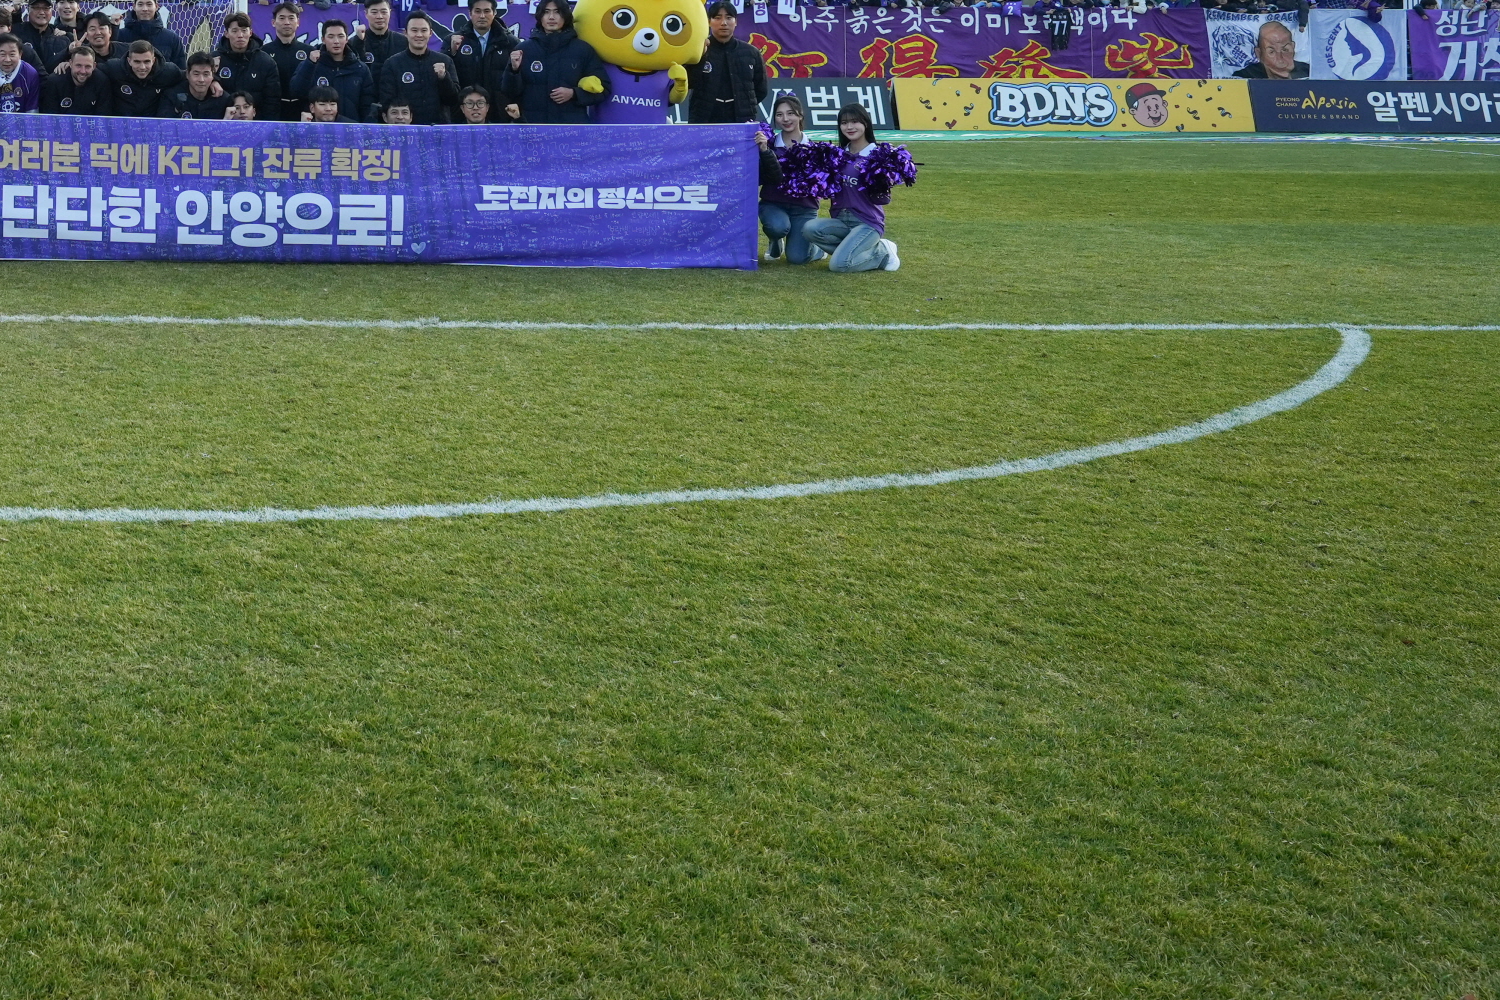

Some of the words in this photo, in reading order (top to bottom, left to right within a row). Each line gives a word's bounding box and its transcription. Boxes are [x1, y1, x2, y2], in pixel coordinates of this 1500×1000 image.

[788, 6, 839, 32] 아주
[846, 7, 895, 35] 붉은
[901, 7, 952, 35] 것은
[961, 7, 1010, 36] 이미
[1008, 6, 1014, 16] 2
[1206, 9, 1260, 22] REMEMBER
[1053, 20, 1068, 36] 77
[1325, 23, 1342, 69] CRESCENT
[610, 94, 662, 107] ANYANG
[805, 85, 886, 126] 범계
[995, 82, 1117, 125] BDNS
[89, 143, 149, 175] 덕에
[158, 145, 254, 177] K리그1
[262, 147, 322, 180] 잔류
[331, 147, 400, 182] 확정!
[474, 185, 594, 211] 도전자의
[597, 185, 718, 211] 정신으로
[3, 184, 161, 244] 단단한
[176, 189, 404, 248] 안양으로!
